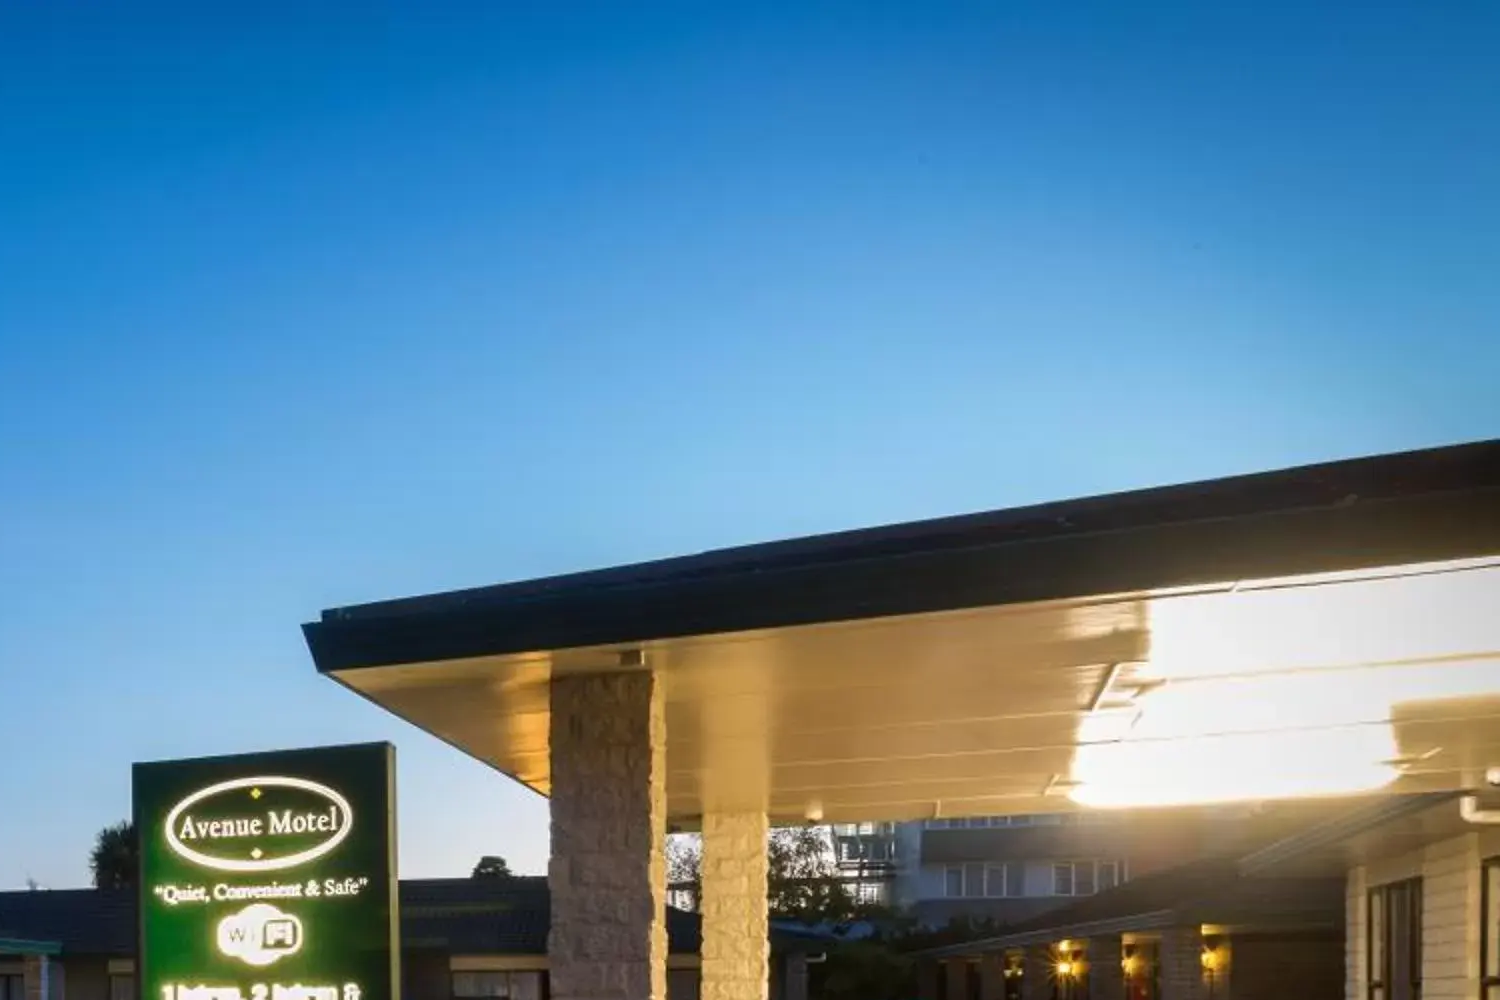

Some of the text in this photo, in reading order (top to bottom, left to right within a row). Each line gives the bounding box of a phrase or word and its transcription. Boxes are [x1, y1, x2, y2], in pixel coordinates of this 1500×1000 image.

[179, 805, 338, 839] Avenue Motel
[213, 881, 302, 901] Convenient
[305, 879, 321, 897] &
